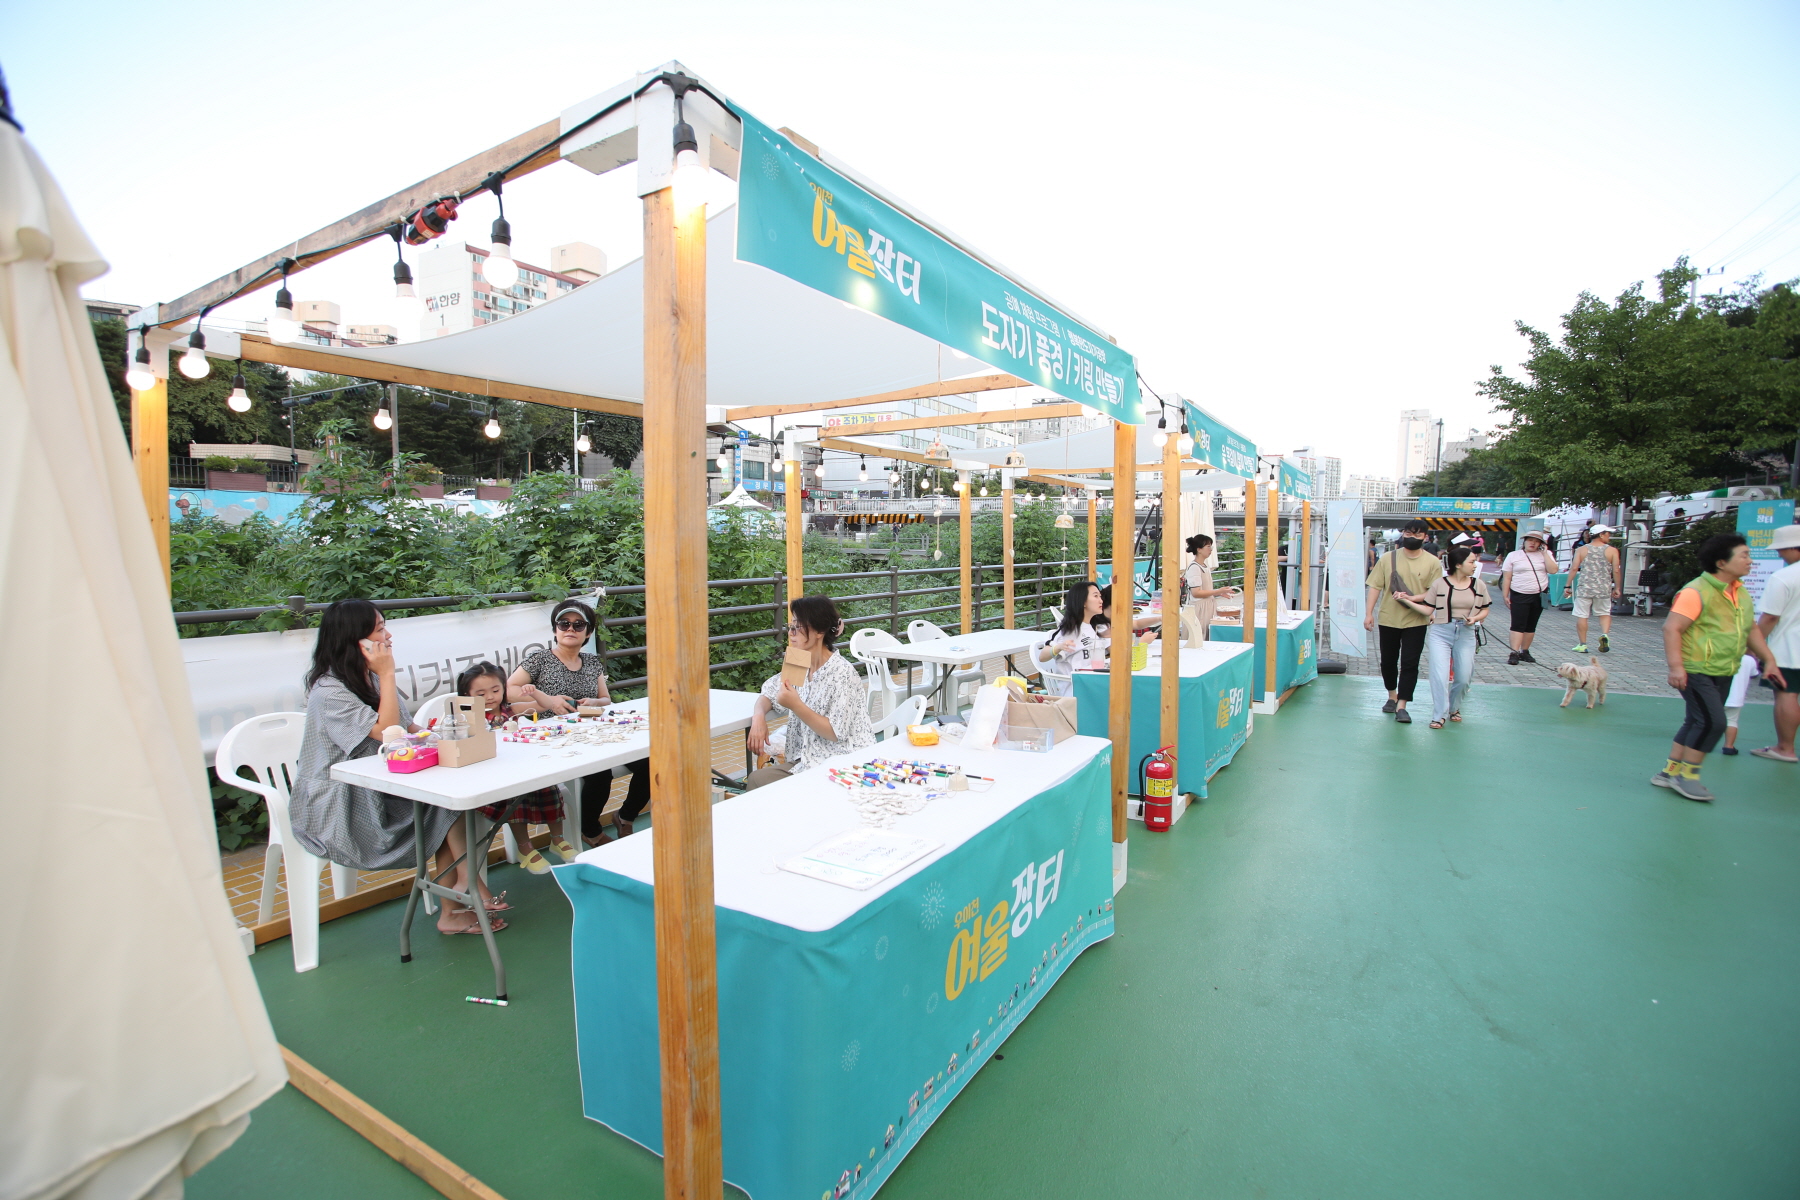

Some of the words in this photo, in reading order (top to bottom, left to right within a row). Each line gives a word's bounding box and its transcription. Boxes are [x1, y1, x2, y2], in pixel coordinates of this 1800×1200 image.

[439, 292, 460, 308] 한양
[1034, 309, 1061, 338] 프로그램
[981, 300, 1033, 367] 도자기
[1035, 330, 1064, 380] 풍경
[1073, 352, 1095, 396] 키링
[1095, 366, 1125, 409] 만들기
[1756, 514, 1773, 524] 장터
